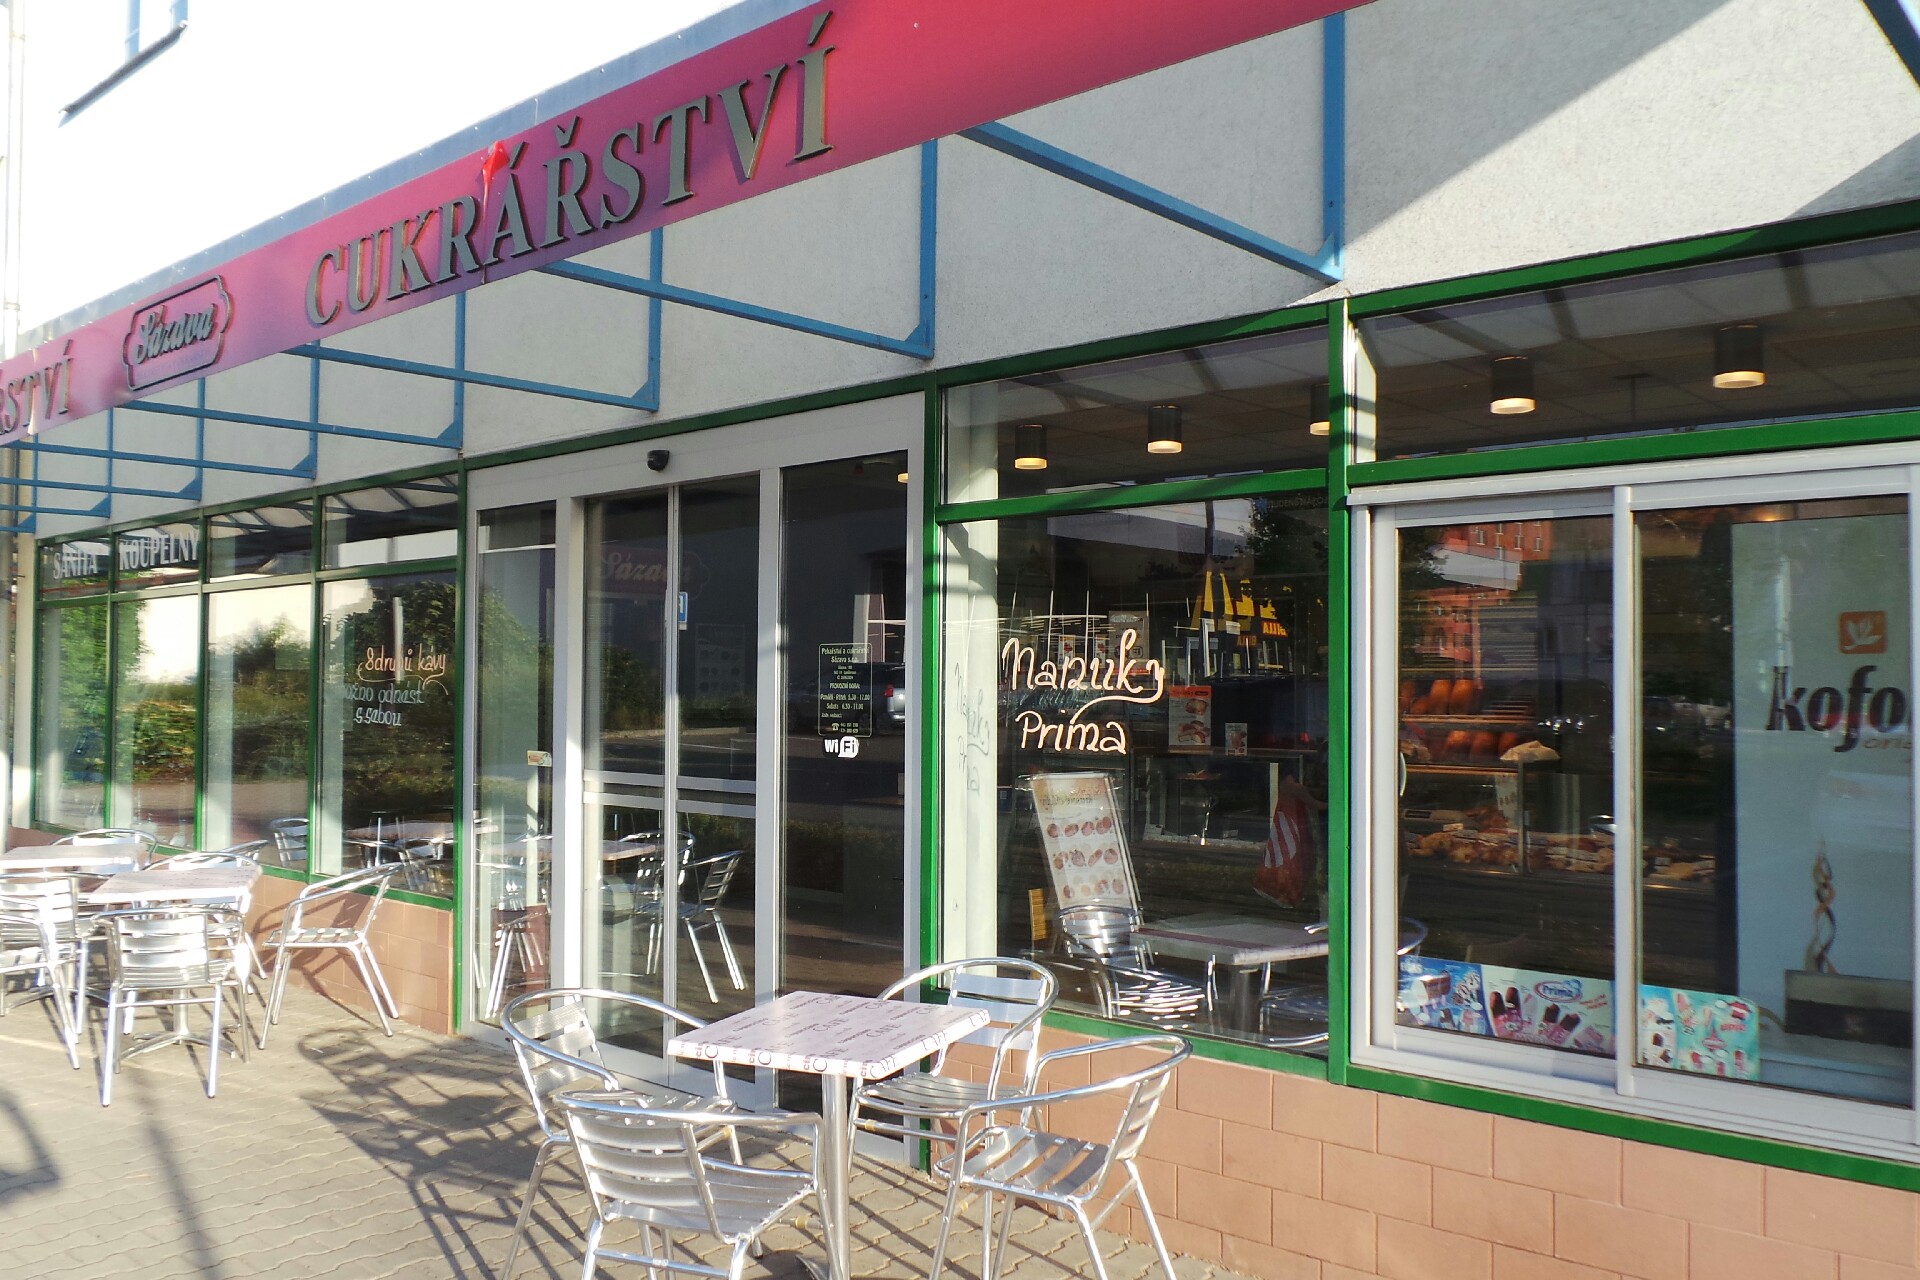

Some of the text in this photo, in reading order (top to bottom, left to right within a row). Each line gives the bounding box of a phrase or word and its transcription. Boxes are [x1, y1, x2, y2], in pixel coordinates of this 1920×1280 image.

[306, 9, 836, 325] CUKRÁŘSTVÍ
[135, 303, 216, 364] Sázava
[0, 338, 74, 436] STVÍ
[119, 530, 201, 571] KOUPELNY
[418, 643, 446, 682] kávy
[1015, 711, 1127, 755] Prima
[1766, 665, 1913, 752] kofo
